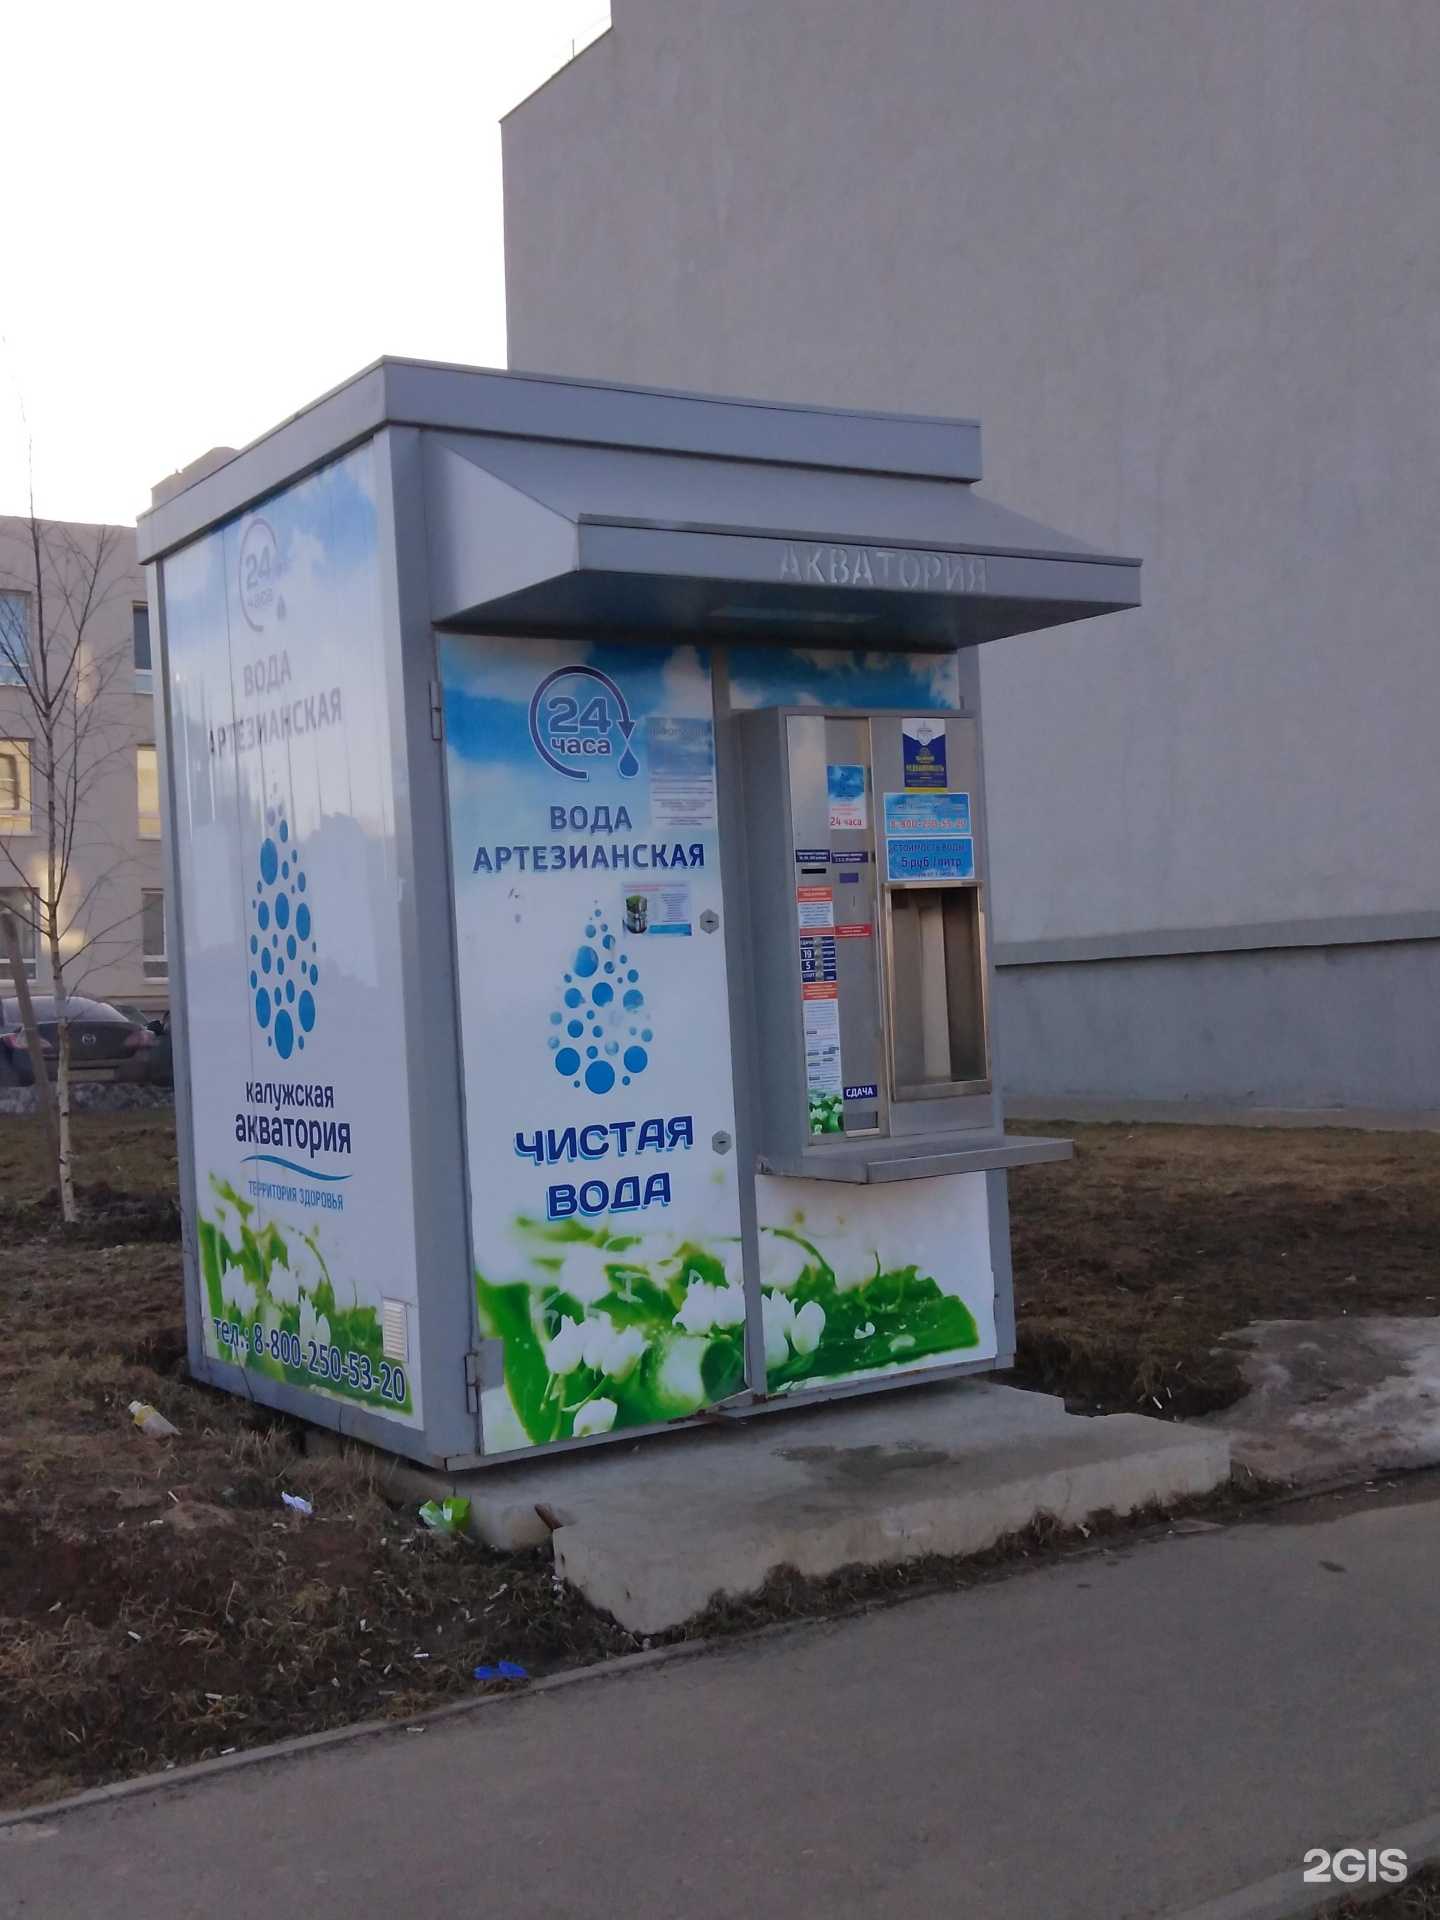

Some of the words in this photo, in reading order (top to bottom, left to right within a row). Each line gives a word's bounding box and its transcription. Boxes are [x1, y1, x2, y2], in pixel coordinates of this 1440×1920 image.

[246, 546, 272, 592] 24
[779, 545, 987, 592] АКВАТОРИЯ
[243, 650, 292, 697] ВОДА
[208, 686, 342, 757] АРТЕЗИАНСКАЯ
[547, 697, 612, 734] 24
[551, 736, 612, 755] часа
[550, 805, 632, 834] ВОДА
[472, 843, 704, 873] АРТЕЗИАНСКАЯ
[805, 961, 811, 970] 5
[246, 1081, 334, 1111] калужская
[845, 1086, 874, 1098] СДАЧА
[235, 1113, 352, 1158] акватория
[514, 1115, 694, 1166] ЧИСТАЯ
[248, 1180, 297, 1202] ТЕРРИТОРИЯ
[299, 1188, 344, 1212] ЗДОРОВЬЯ
[546, 1172, 672, 1221] ВОДА
[213, 1317, 250, 1350] тел.:
[253, 1322, 407, 1404] 8-800-250-53-20
